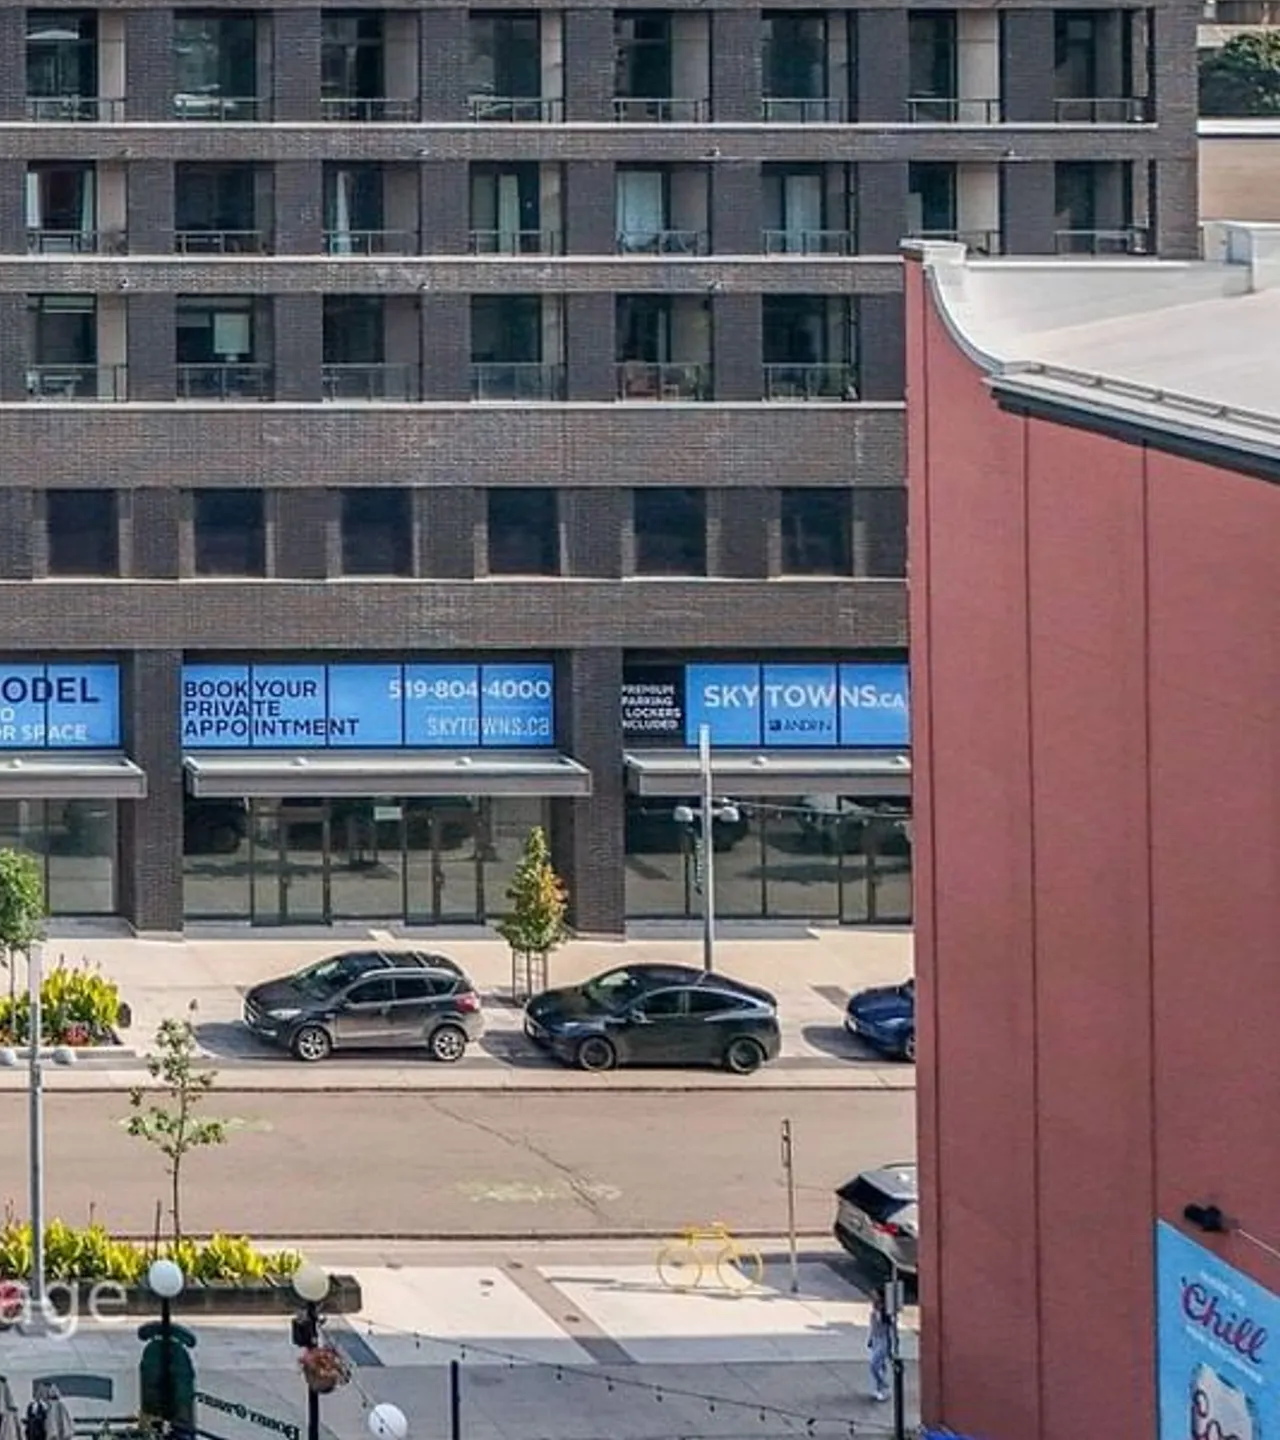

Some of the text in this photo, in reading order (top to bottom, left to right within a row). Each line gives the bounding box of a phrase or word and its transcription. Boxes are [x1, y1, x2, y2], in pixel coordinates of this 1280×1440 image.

[184, 680, 317, 698] BOOK YOUR
[184, 700, 281, 717] PRIVATE
[22, 724, 88, 741] SPACE
[184, 718, 360, 737] APPOINTMENT
[1180, 1276, 1269, 1365] Chill
